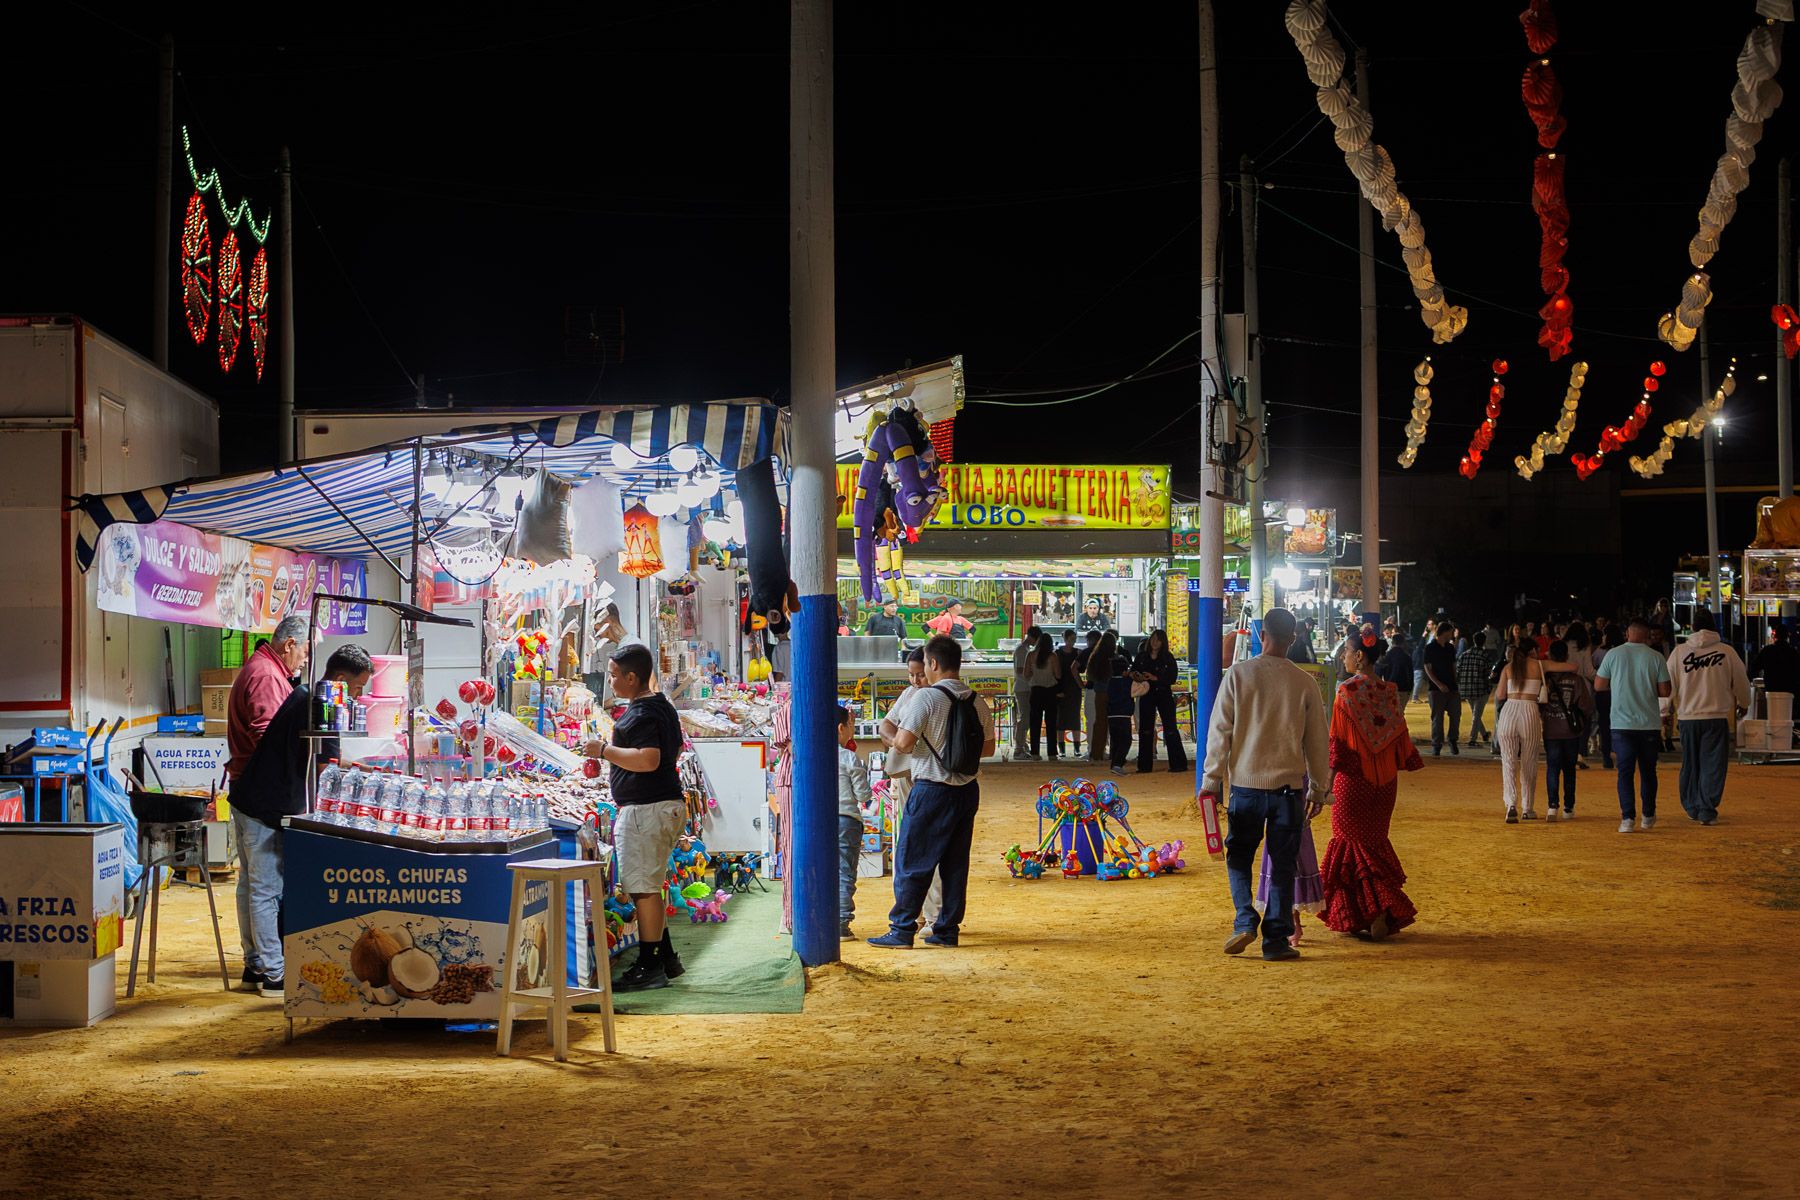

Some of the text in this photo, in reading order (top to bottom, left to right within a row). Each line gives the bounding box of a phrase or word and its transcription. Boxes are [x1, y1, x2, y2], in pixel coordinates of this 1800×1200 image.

[144, 536, 177, 568] DULCE
[178, 544, 188, 570] Y
[188, 547, 221, 577] SALADO
[151, 583, 157, 599] Y
[157, 584, 185, 605] BEBIDAS
[155, 749, 222, 758] AGUA FRIA Y
[160, 760, 217, 769] REFRESCOS
[97, 851, 108, 864] AGUA
[109, 848, 118, 861] FRIA
[99, 863, 121, 881] REFRESCOS
[323, 868, 468, 885] COCOS, CHUFAS
[346, 888, 462, 904] ALTRAMUCES
[17, 897, 77, 916] FRIA
[0, 924, 89, 944] RESCOS
